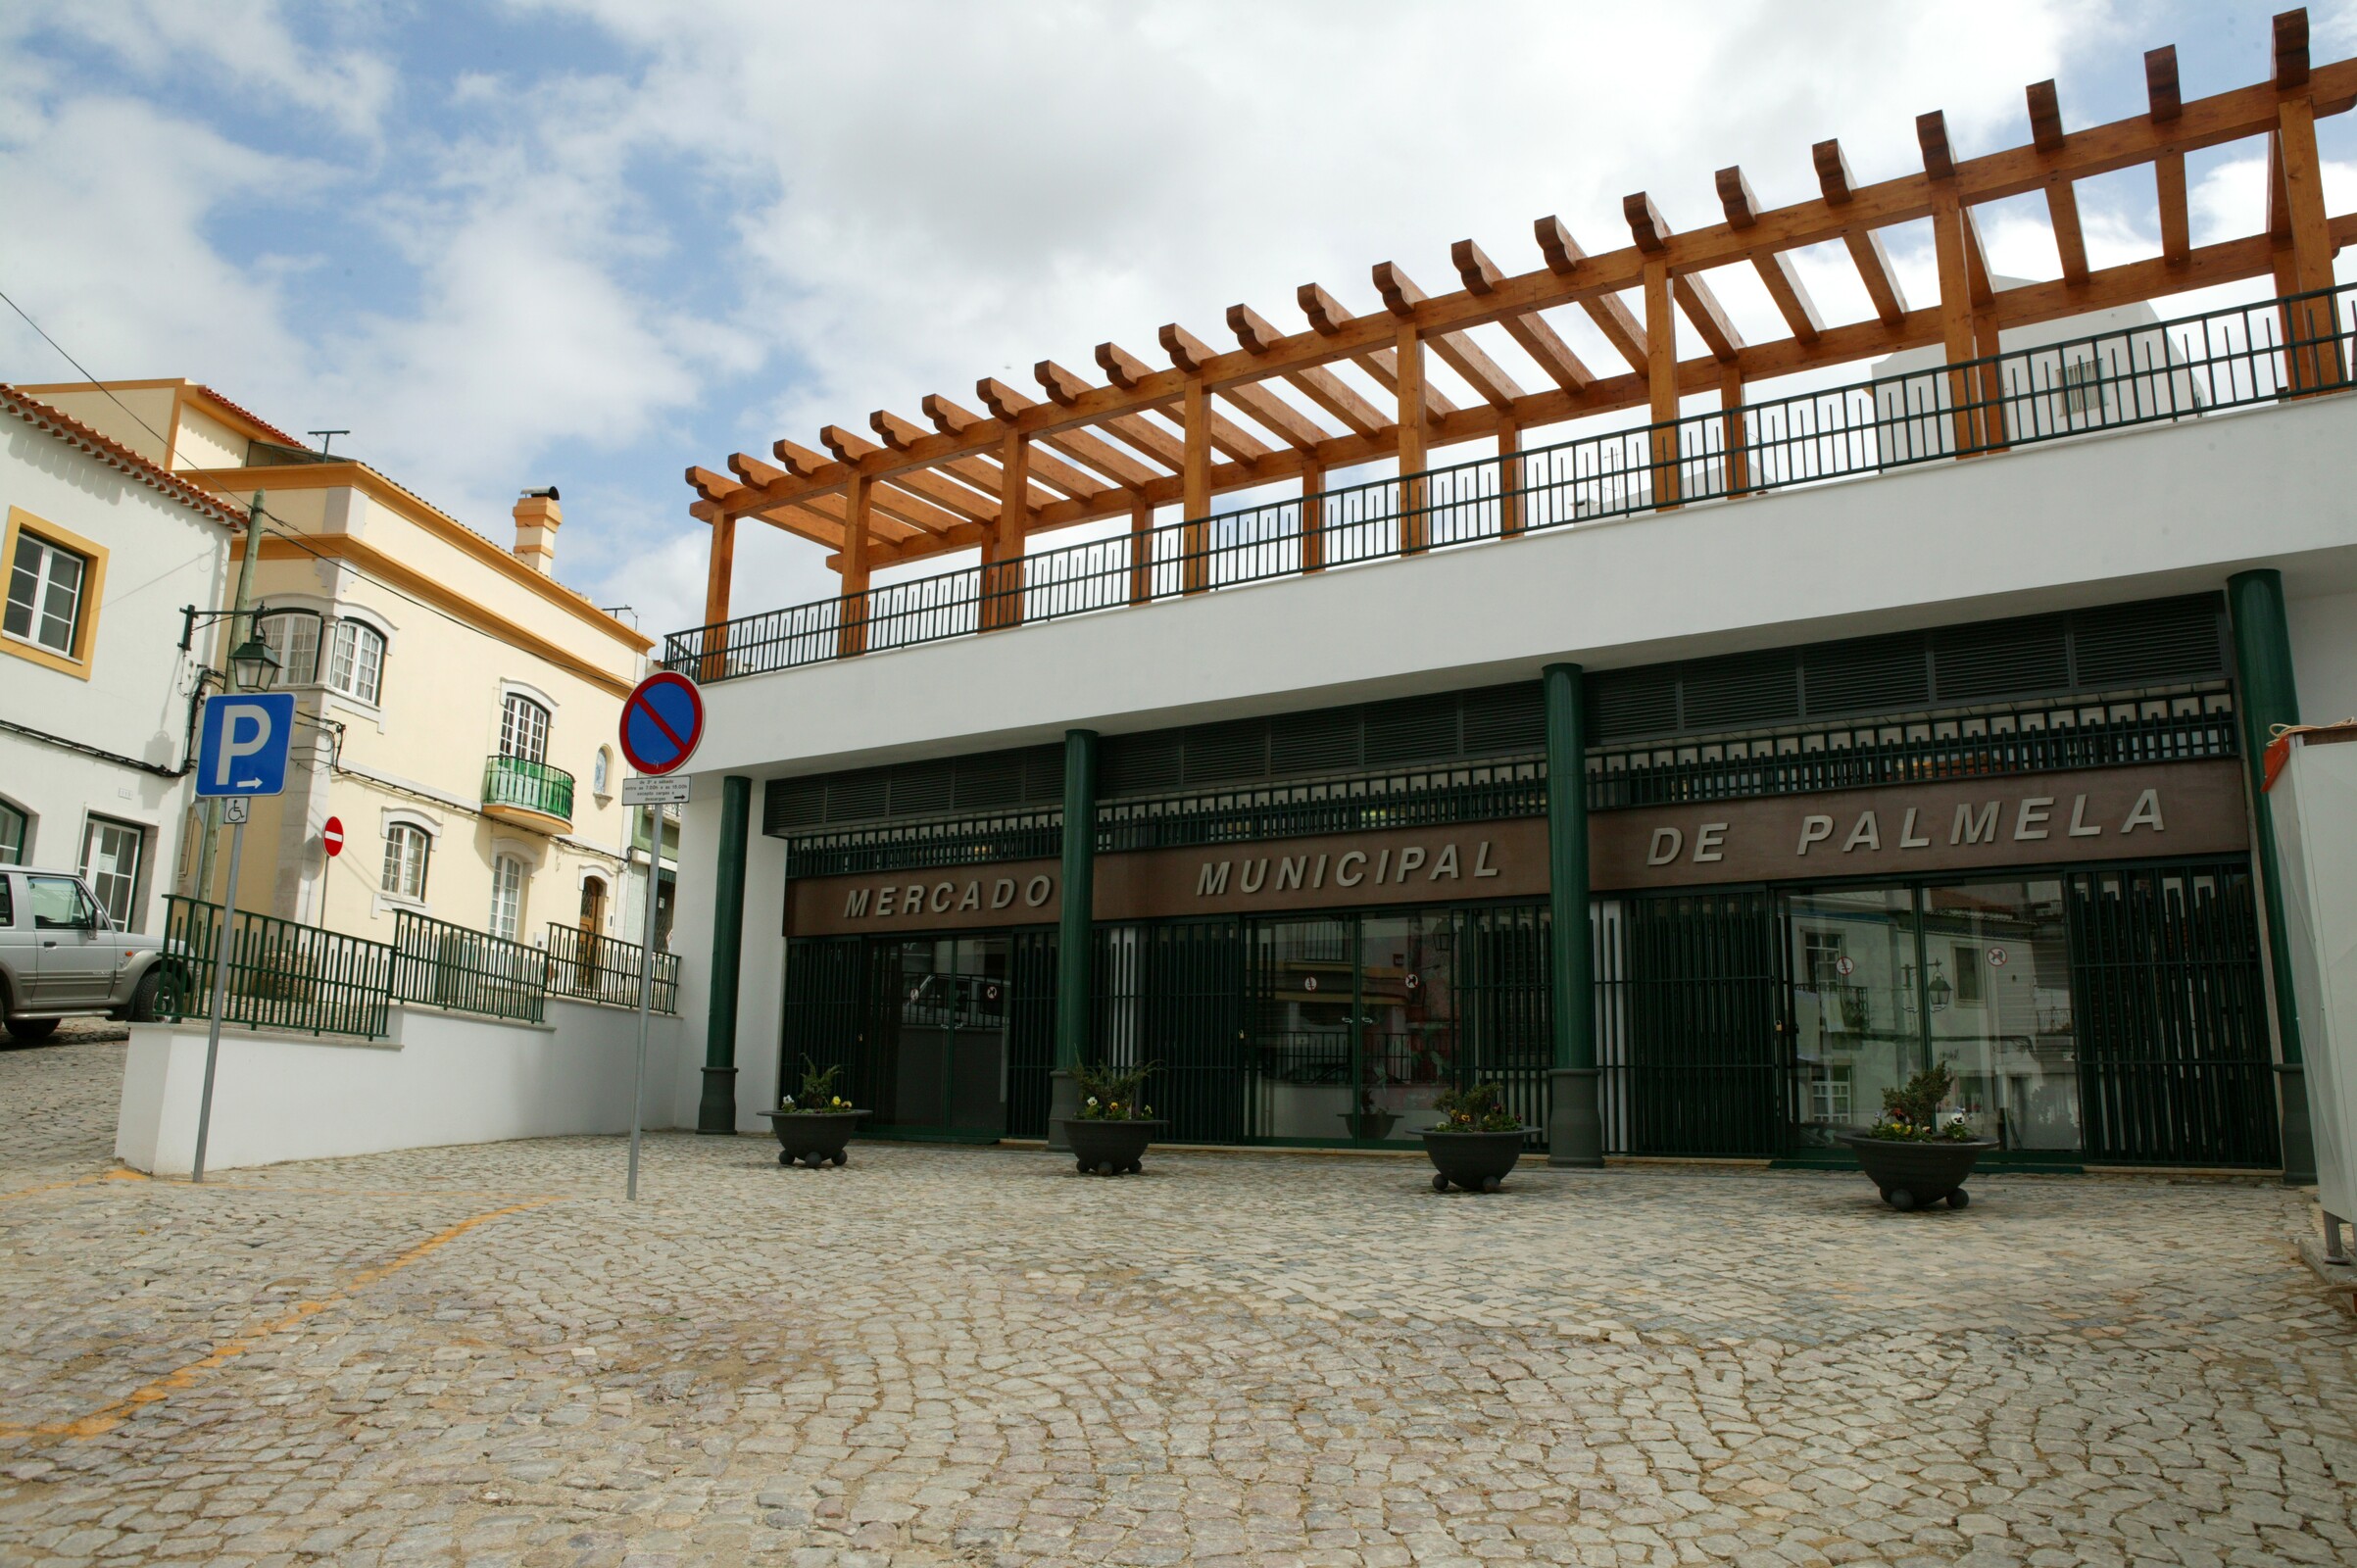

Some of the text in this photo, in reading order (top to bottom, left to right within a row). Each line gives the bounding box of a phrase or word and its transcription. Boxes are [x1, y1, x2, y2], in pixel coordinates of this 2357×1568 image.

[216, 704, 272, 786] P
[844, 788, 2166, 918] MERCADO MUNICIPAL DE PALMELA
